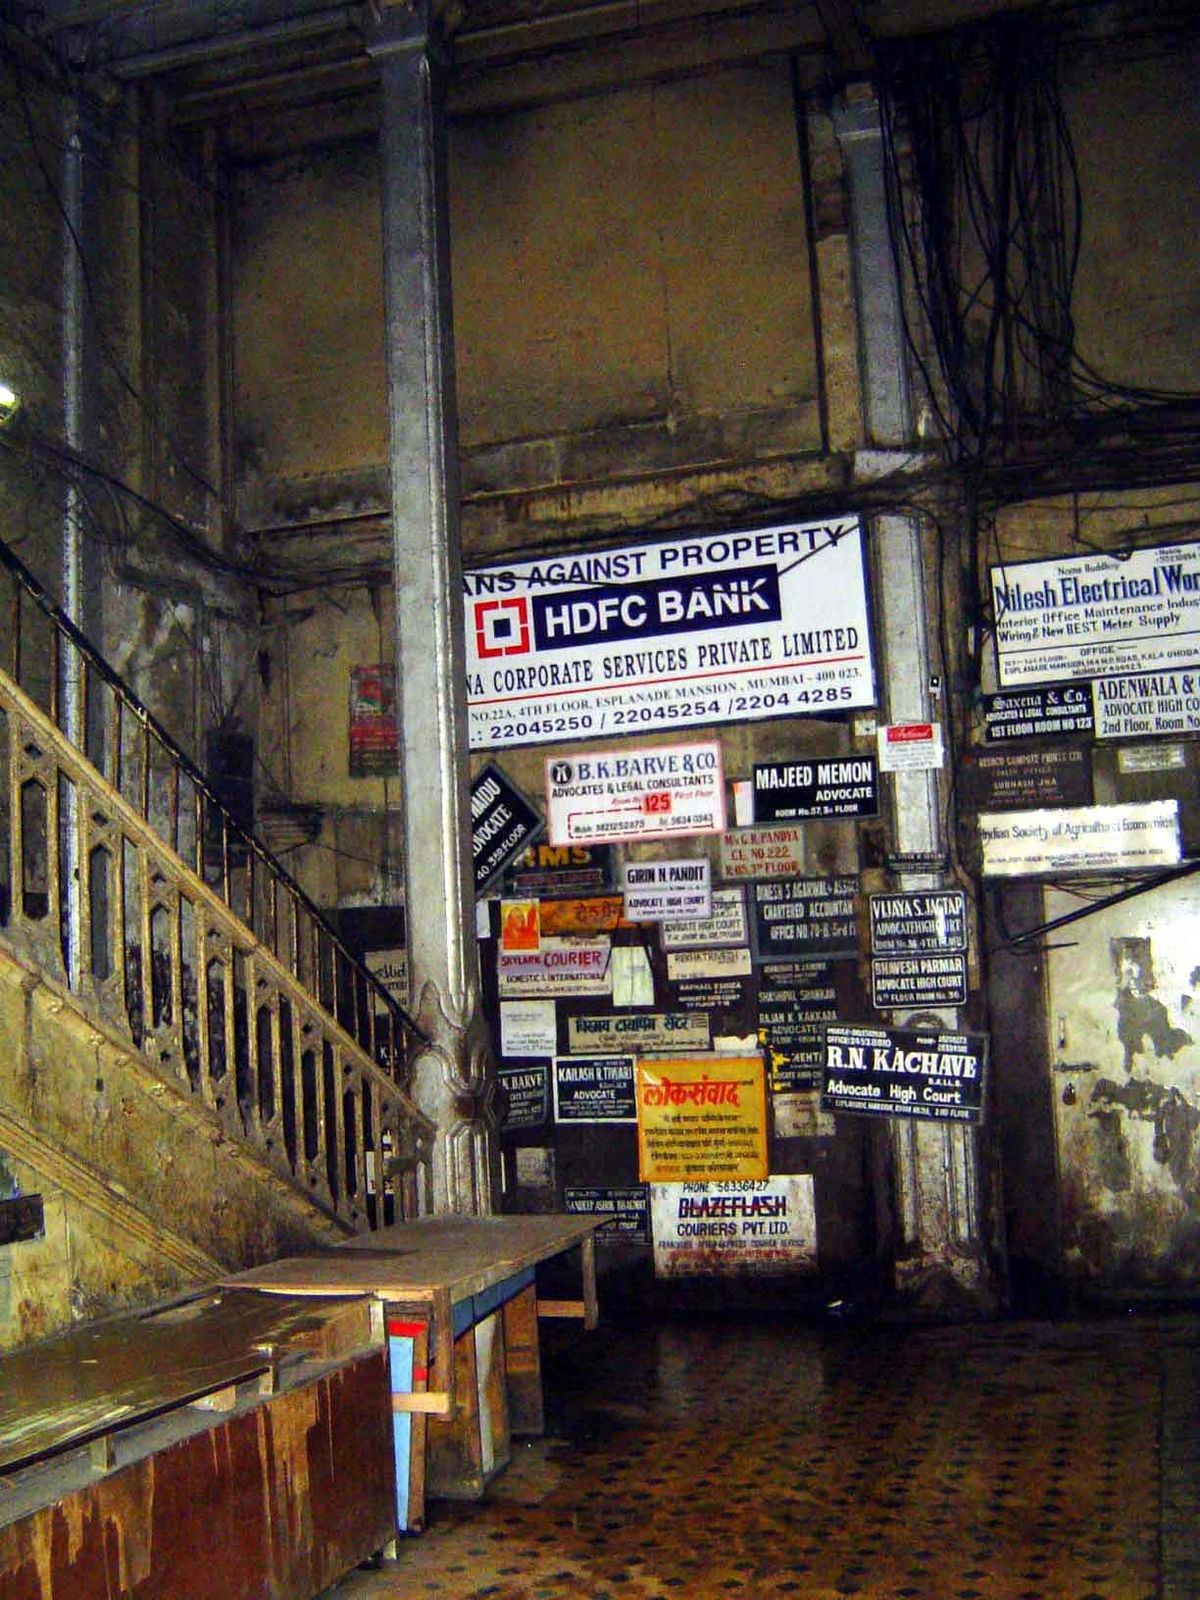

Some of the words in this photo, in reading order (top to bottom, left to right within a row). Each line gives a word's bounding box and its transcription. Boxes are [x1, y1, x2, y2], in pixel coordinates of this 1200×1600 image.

[528, 551, 646, 588] AGAINST
[660, 524, 844, 570] PROPERTY
[995, 580, 1057, 614] Nilesh
[1060, 566, 1160, 608] Electrical
[545, 594, 647, 638] HDFC
[658, 578, 770, 622] BANK
[1042, 610, 1080, 624] Office
[1084, 602, 1163, 620] Maintenance
[1042, 626, 1064, 638] New
[1066, 621, 1098, 636] BEST
[1102, 618, 1133, 631] Meter
[1138, 612, 1182, 630] Supply
[493, 659, 594, 693] CORPORATE
[603, 647, 688, 680] SERVICES
[698, 635, 773, 668] PRIVATE
[783, 626, 860, 658] LIMITED
[1080, 645, 1115, 657] OFFICE
[1099, 674, 1178, 701] ADENWALA
[1182, 673, 1196, 694] &
[595, 689, 672, 711] ESPLANADE
[992, 693, 1042, 710] Saxena
[1047, 690, 1059, 705] &
[1104, 701, 1155, 718] ADVOCATE
[1158, 699, 1184, 715] HIGH
[490, 714, 593, 741] 22045250
[614, 699, 721, 727] 22045254
[798, 685, 852, 706] 4285
[1007, 722, 1033, 736] FLOOR
[1102, 720, 1121, 735] 2nd
[1156, 716, 1184, 731] Room
[682, 753, 694, 772] &
[756, 765, 813, 790] MAJEED
[818, 761, 873, 785] MEMON
[552, 784, 604, 798] ADVOCATES
[607, 783, 615, 795] &
[617, 781, 644, 794] LEGAL
[647, 775, 714, 790] CONSULTANTS
[815, 786, 873, 802] ADVOCATE
[644, 793, 671, 813] 125
[1012, 823, 1049, 842] Society
[627, 868, 656, 884] GIRIN
[669, 865, 705, 883] PANDIT
[628, 897, 663, 908] ADVOCATE
[764, 902, 804, 920] CHARTERED
[872, 899, 912, 919] VIJAYA
[543, 951, 602, 968] COURIER
[875, 961, 919, 975] BHAVESH
[920, 958, 963, 973] PARMAR
[877, 979, 916, 990] ADVOCATE
[917, 978, 936, 990] HIGH
[937, 976, 962, 988] COURT
[827, 1046, 868, 1071] R.N.
[873, 1047, 977, 1079] KACHAVE
[558, 1067, 595, 1082] KAILASH
[573, 1089, 616, 1099] ADVOCATE
[643, 1074, 741, 1107] लोकसंवाद
[827, 1079, 881, 1098] Advocate
[889, 1082, 917, 1102] High
[923, 1086, 962, 1105] Court
[678, 1195, 788, 1219] BLAZEFLASH
[677, 1222, 737, 1237] COURIERS
